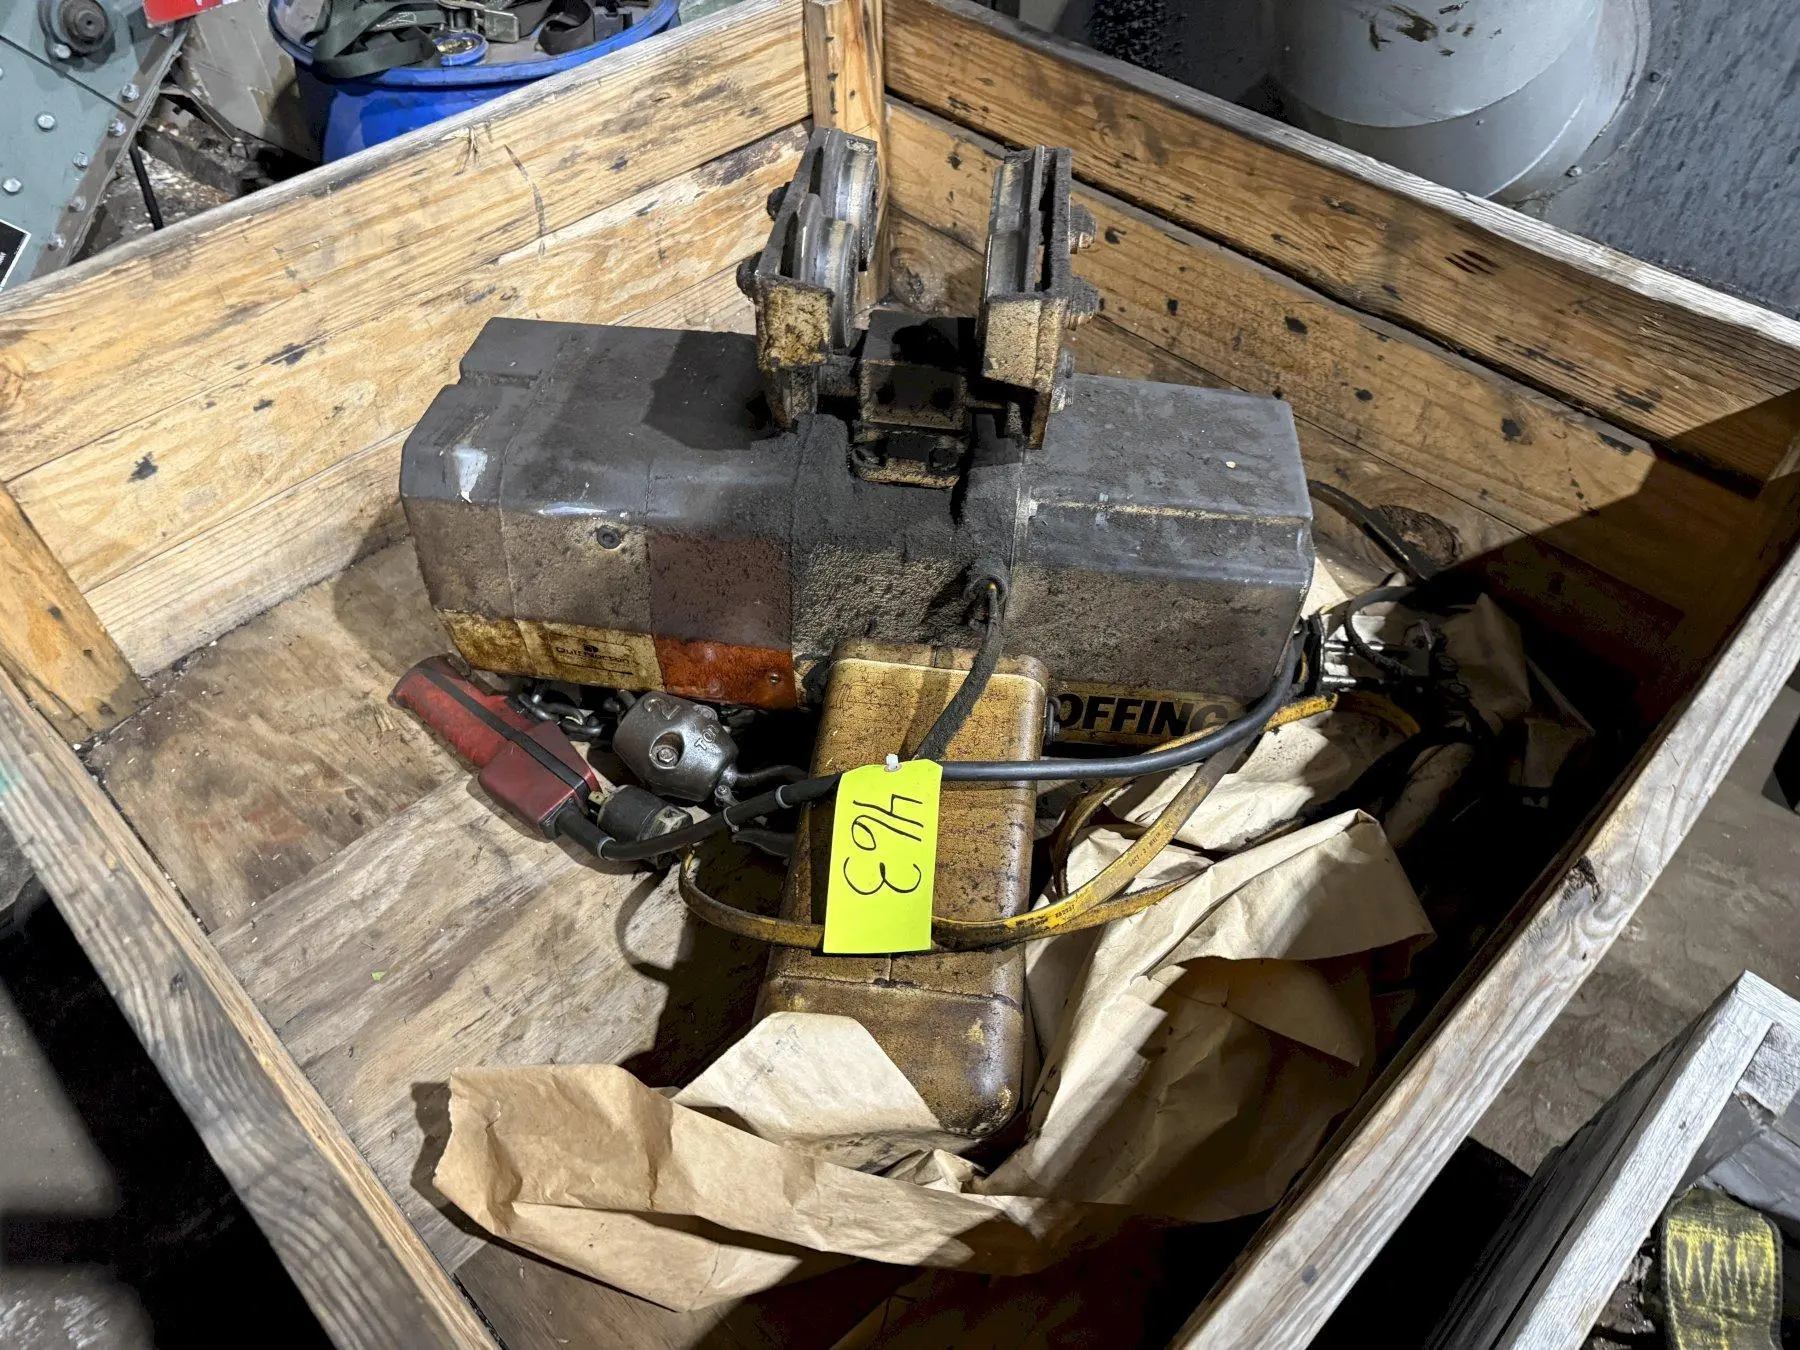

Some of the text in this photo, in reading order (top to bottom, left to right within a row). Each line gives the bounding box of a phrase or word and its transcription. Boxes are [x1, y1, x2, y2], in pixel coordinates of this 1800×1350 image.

[643, 698, 681, 720] 2
[1055, 693, 1228, 737] OFFING
[843, 793, 924, 896] 463
